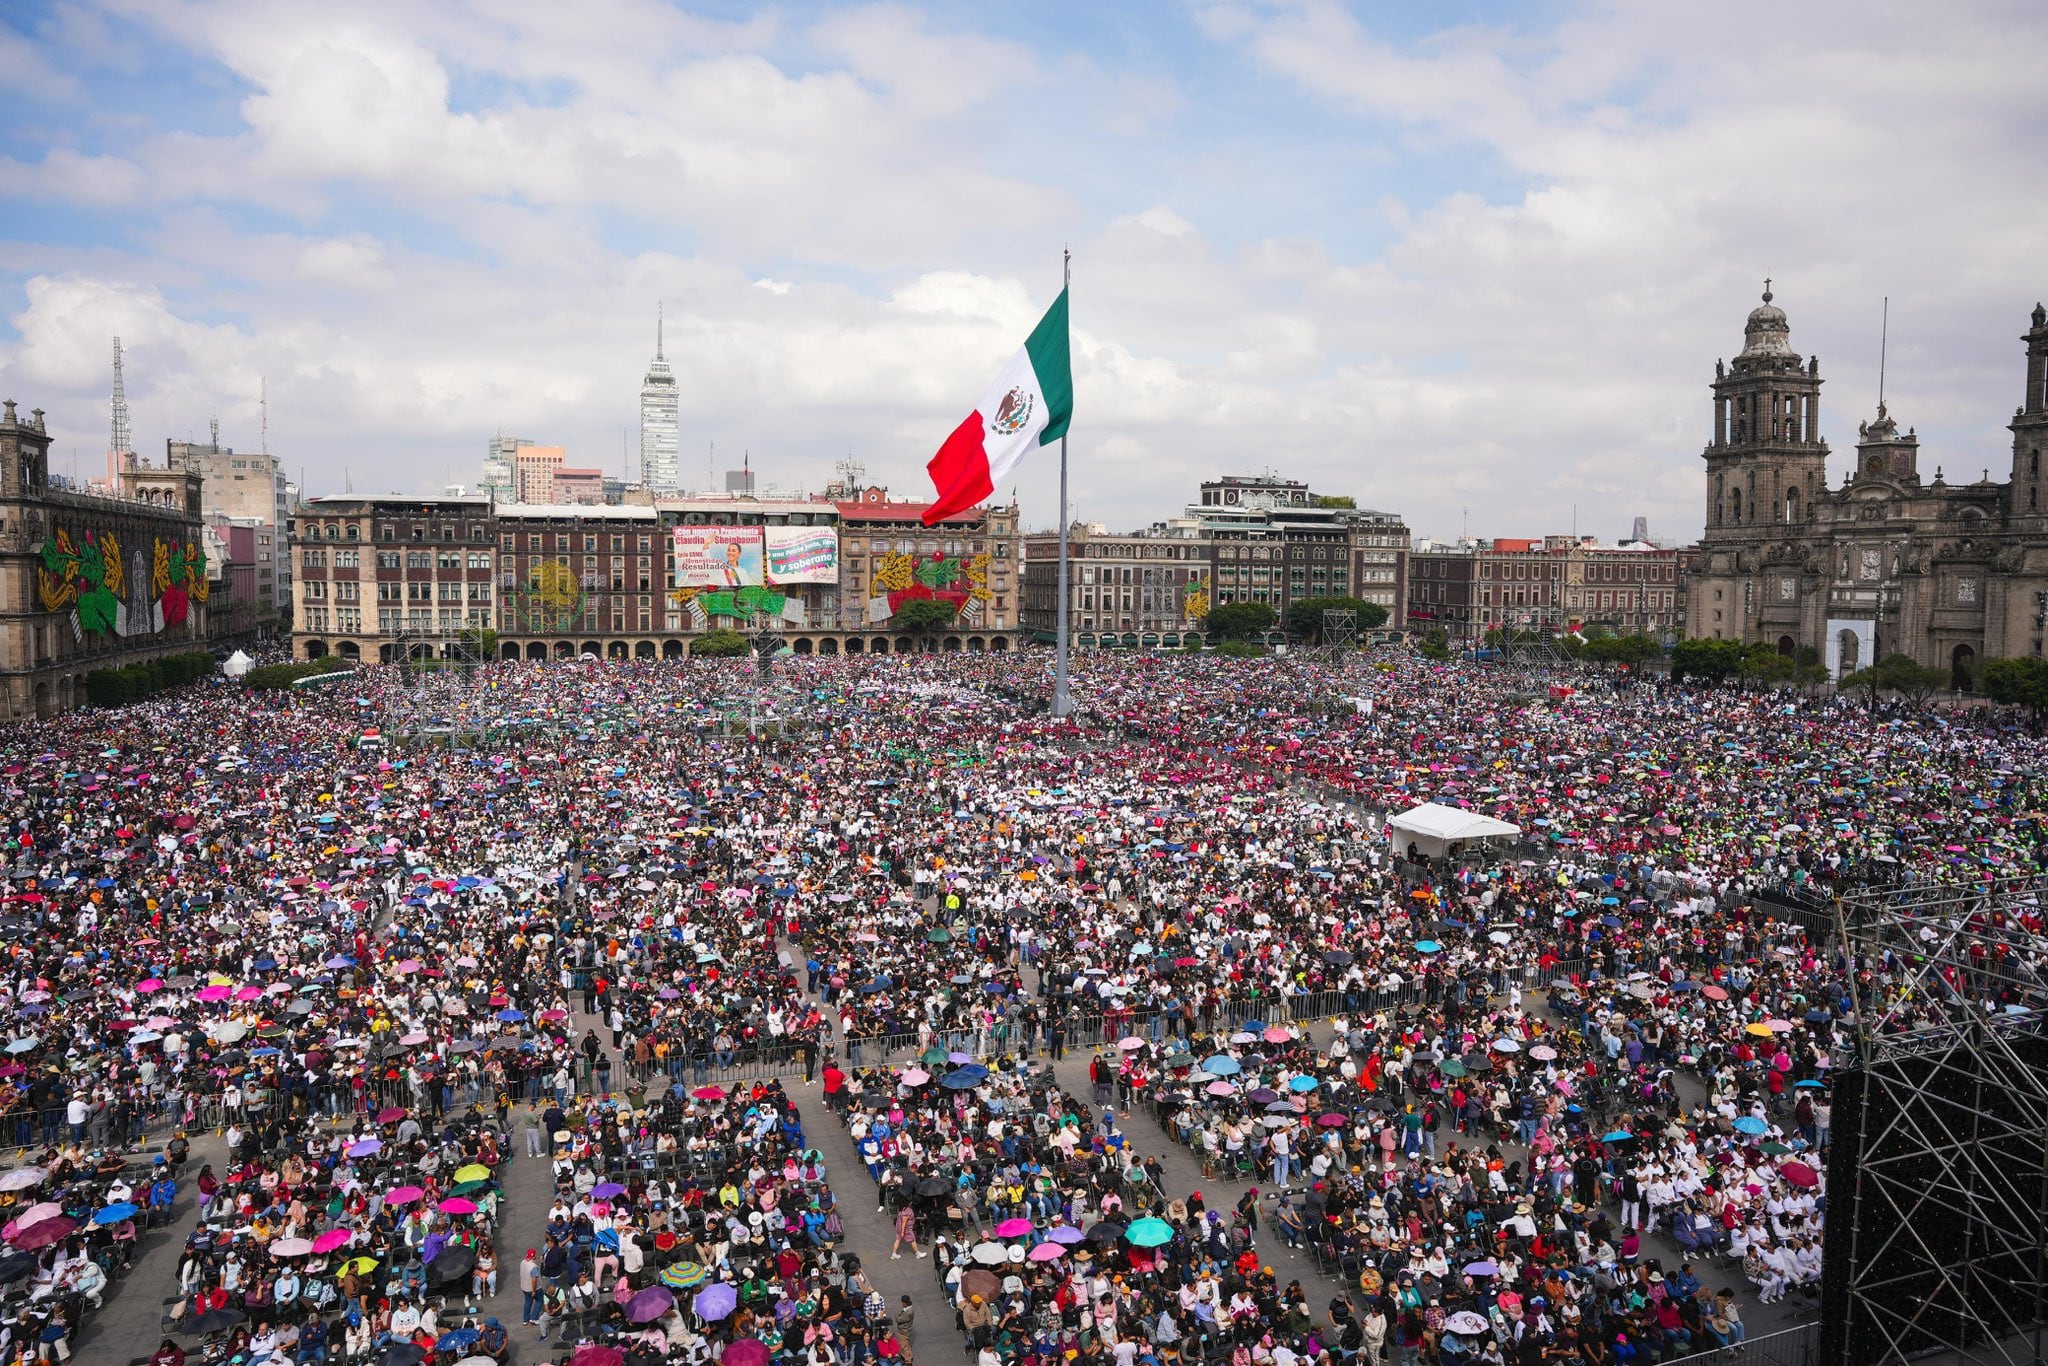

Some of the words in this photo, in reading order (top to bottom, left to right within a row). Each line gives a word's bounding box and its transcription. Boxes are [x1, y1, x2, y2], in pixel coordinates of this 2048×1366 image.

[720, 527, 758, 535] Presidenta
[675, 536, 705, 544] Claudia
[714, 536, 760, 544] Sheinbaum!
[778, 564, 786, 573] y
